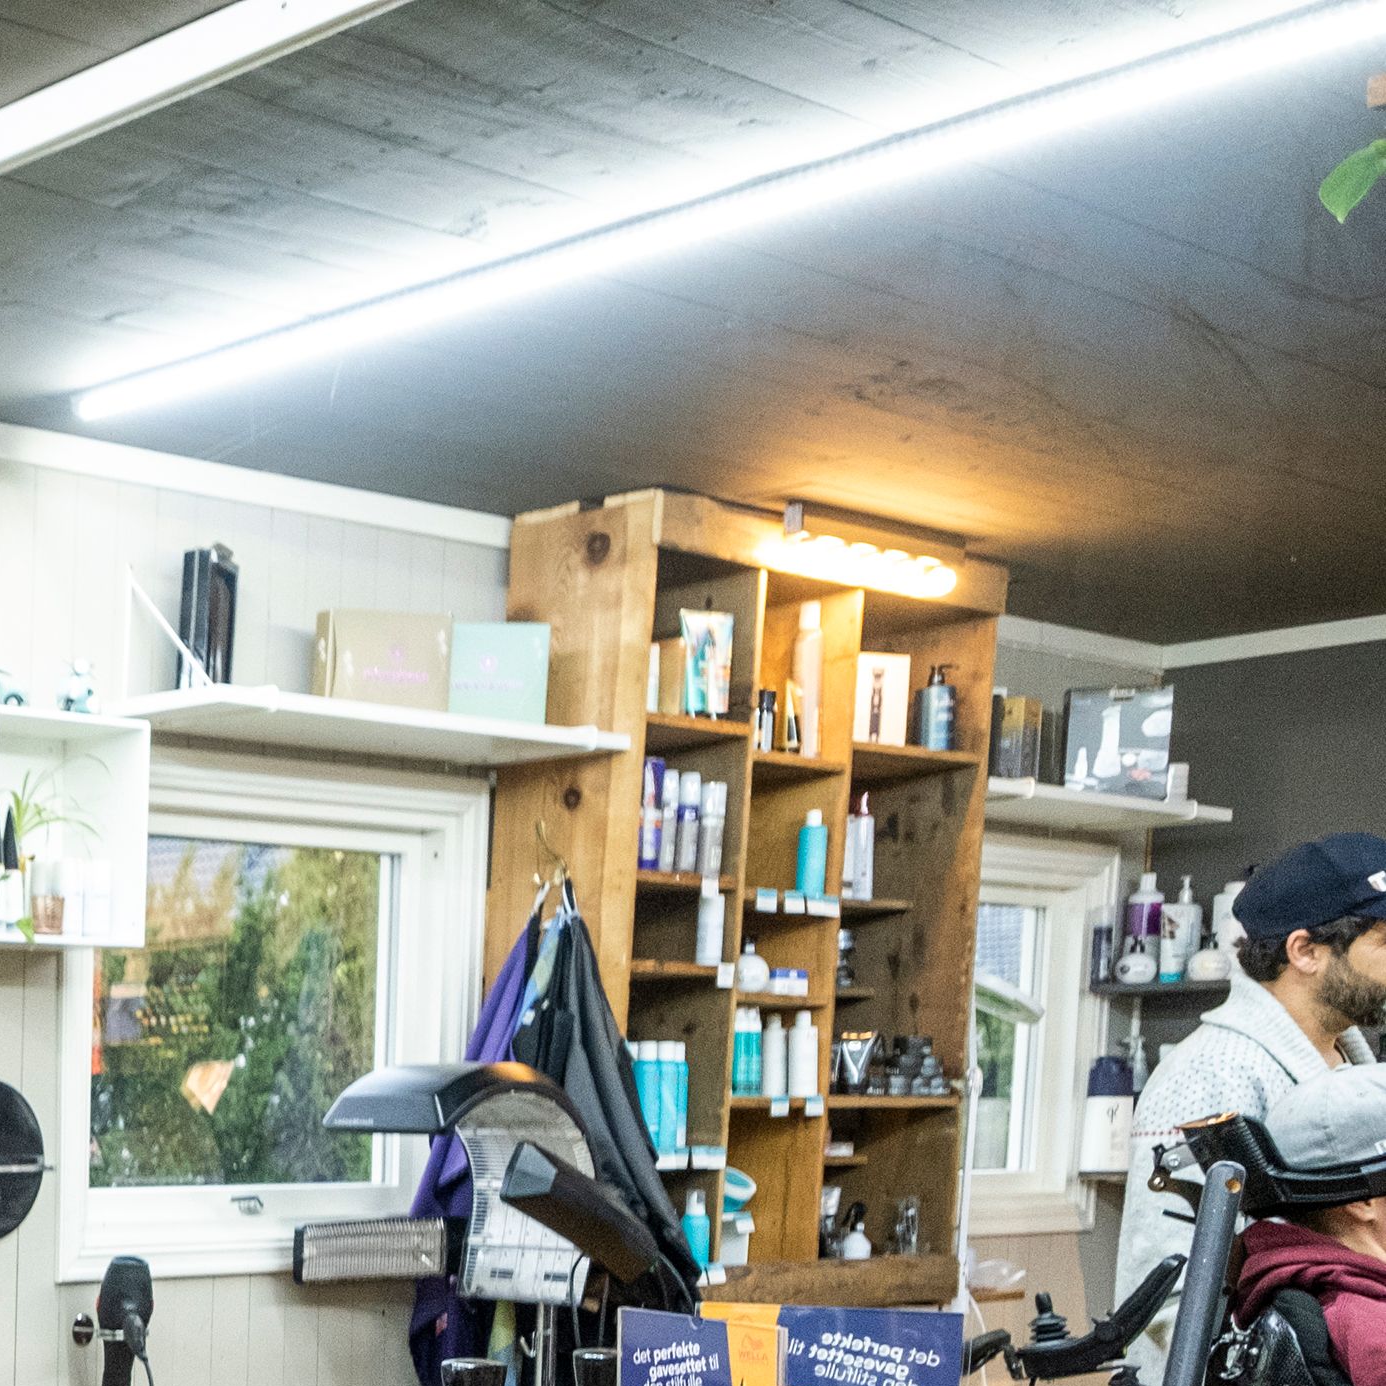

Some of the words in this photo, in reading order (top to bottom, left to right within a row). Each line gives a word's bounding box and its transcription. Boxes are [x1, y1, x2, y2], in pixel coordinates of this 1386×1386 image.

[633, 1348, 651, 1365] det
[653, 1341, 700, 1366] perfekte
[649, 1358, 707, 1382] gavesettet
[709, 1353, 720, 1371] til
